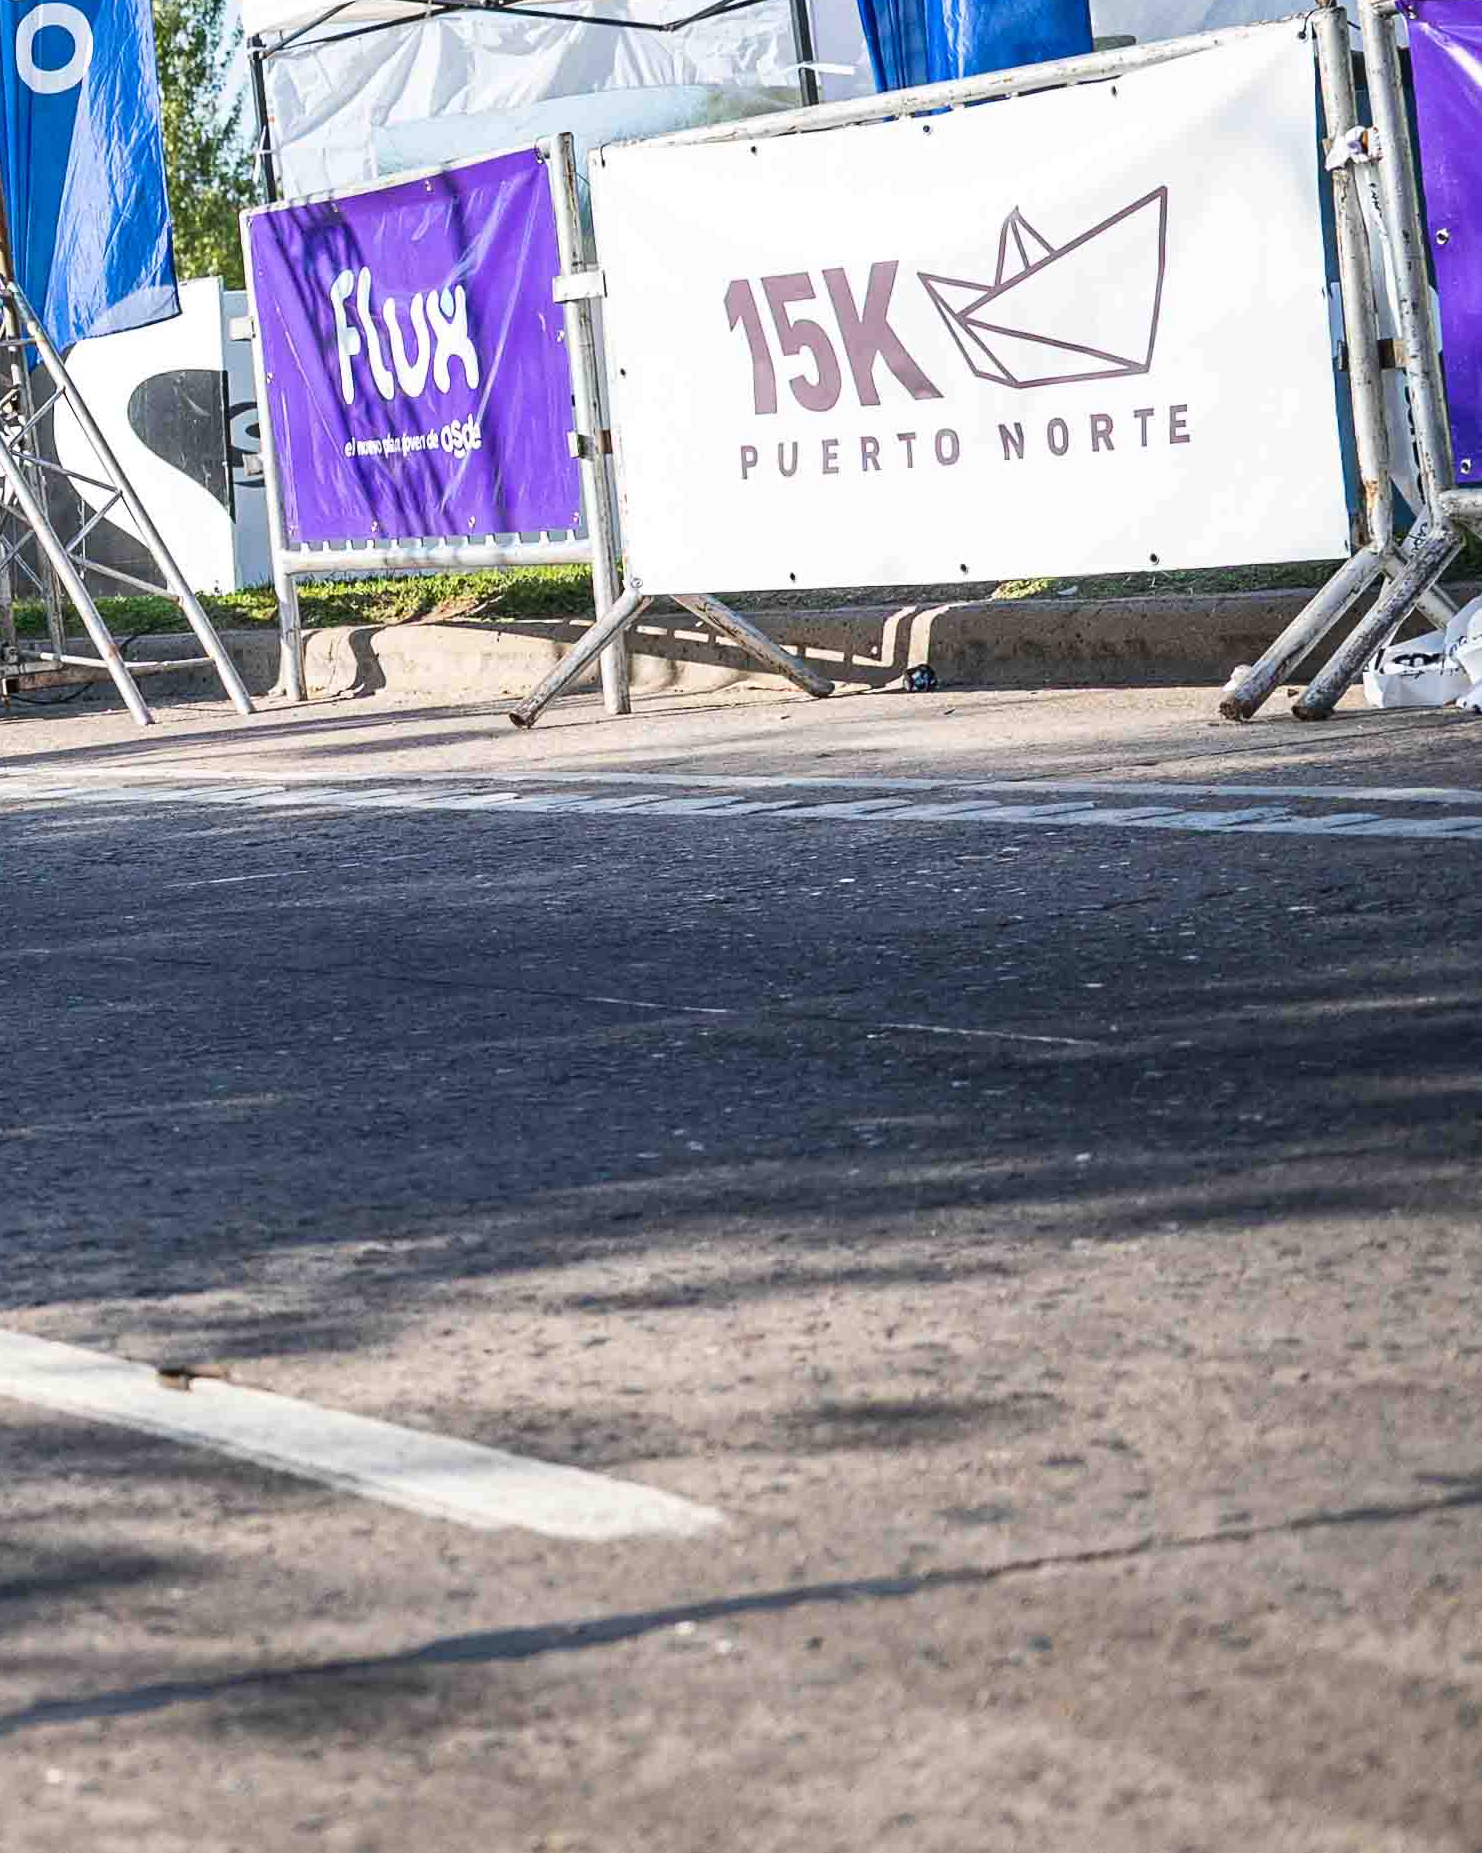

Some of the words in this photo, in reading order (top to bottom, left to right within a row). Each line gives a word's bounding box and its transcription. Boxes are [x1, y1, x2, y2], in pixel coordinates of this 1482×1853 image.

[724, 259, 944, 417] 15K
[441, 413, 482, 459] osde
[741, 427, 961, 482] PUERTO
[1000, 404, 1194, 463] NORTE
